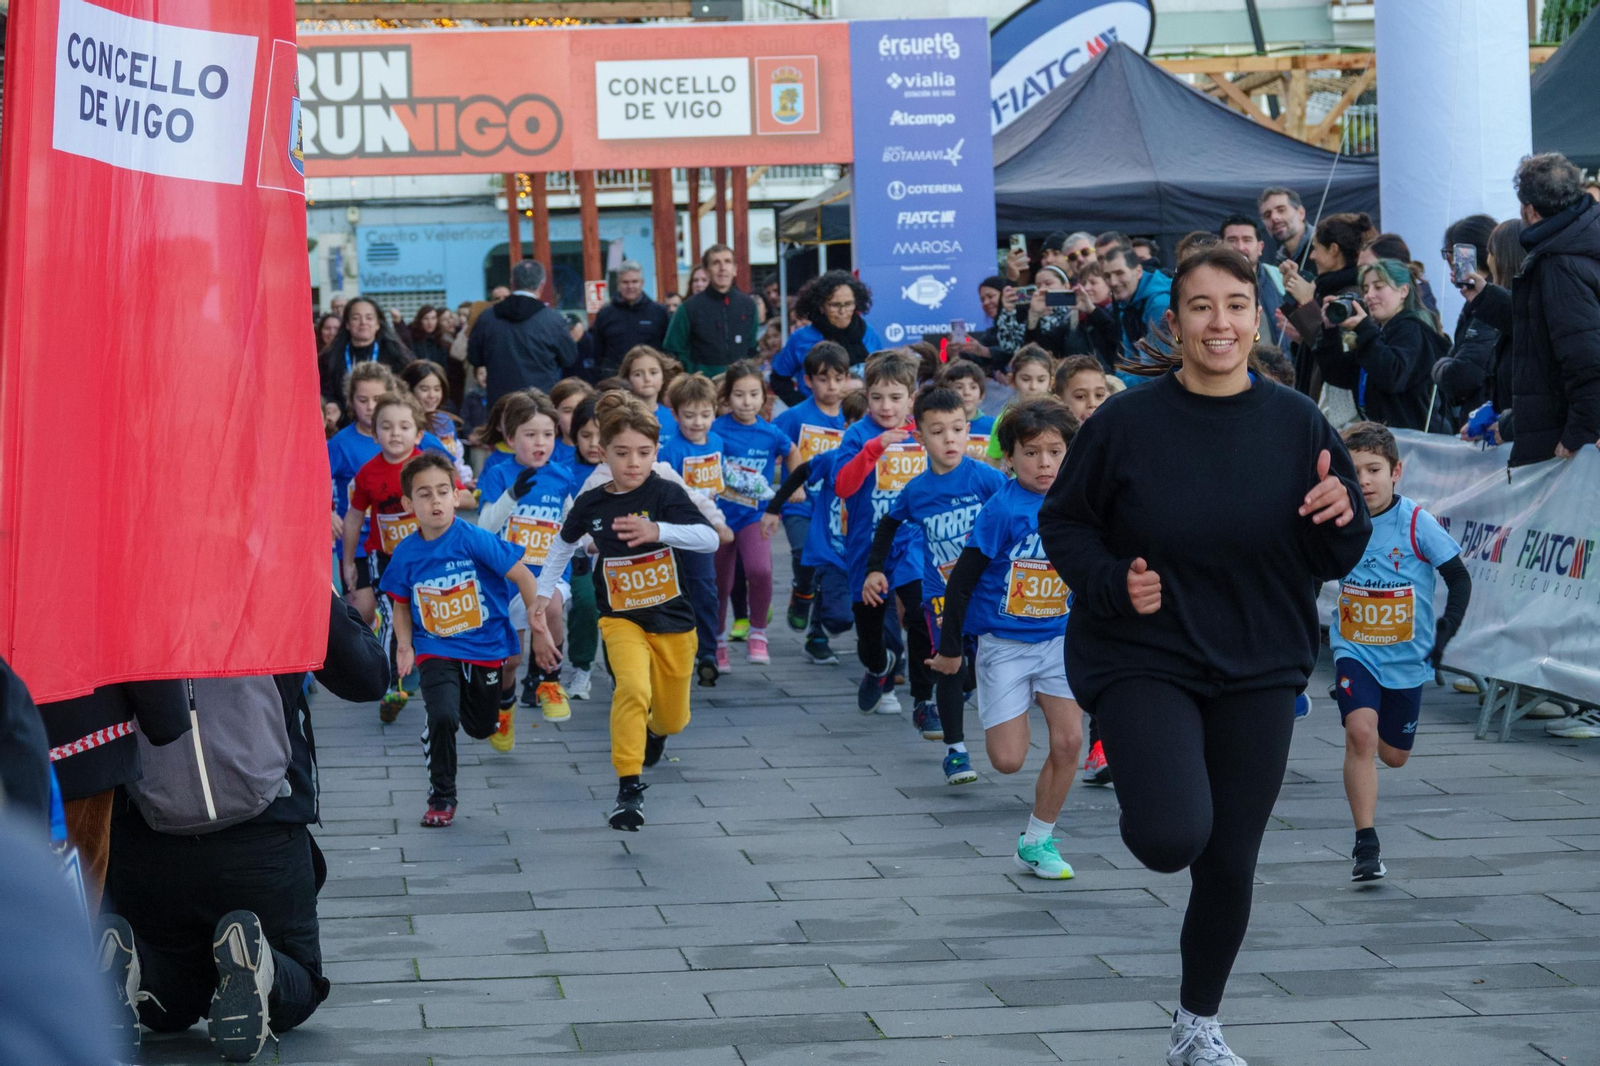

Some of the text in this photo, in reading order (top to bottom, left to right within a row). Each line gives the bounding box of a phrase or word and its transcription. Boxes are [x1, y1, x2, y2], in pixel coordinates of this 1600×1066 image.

[67, 32, 229, 100] CONCELLO
[297, 50, 409, 102] RUN
[608, 75, 737, 96] CONCELLO
[904, 71, 956, 87] vialia
[79, 84, 194, 143] DE VIGO
[625, 100, 723, 120] DE VIGO
[890, 110, 956, 126] Alcampo
[907, 184, 963, 194] COTERENA
[365, 229, 418, 244] Centro
[892, 241, 963, 254] MAROSA
[1516, 529, 1576, 576] FIATC
[619, 564, 669, 591] 3033
[1511, 573, 1582, 600] SEGUROS
[430, 594, 474, 619] 3030
[624, 593, 666, 608] Alcampo
[1352, 602, 1407, 625] 3025
[1353, 630, 1398, 643] Alcampo
